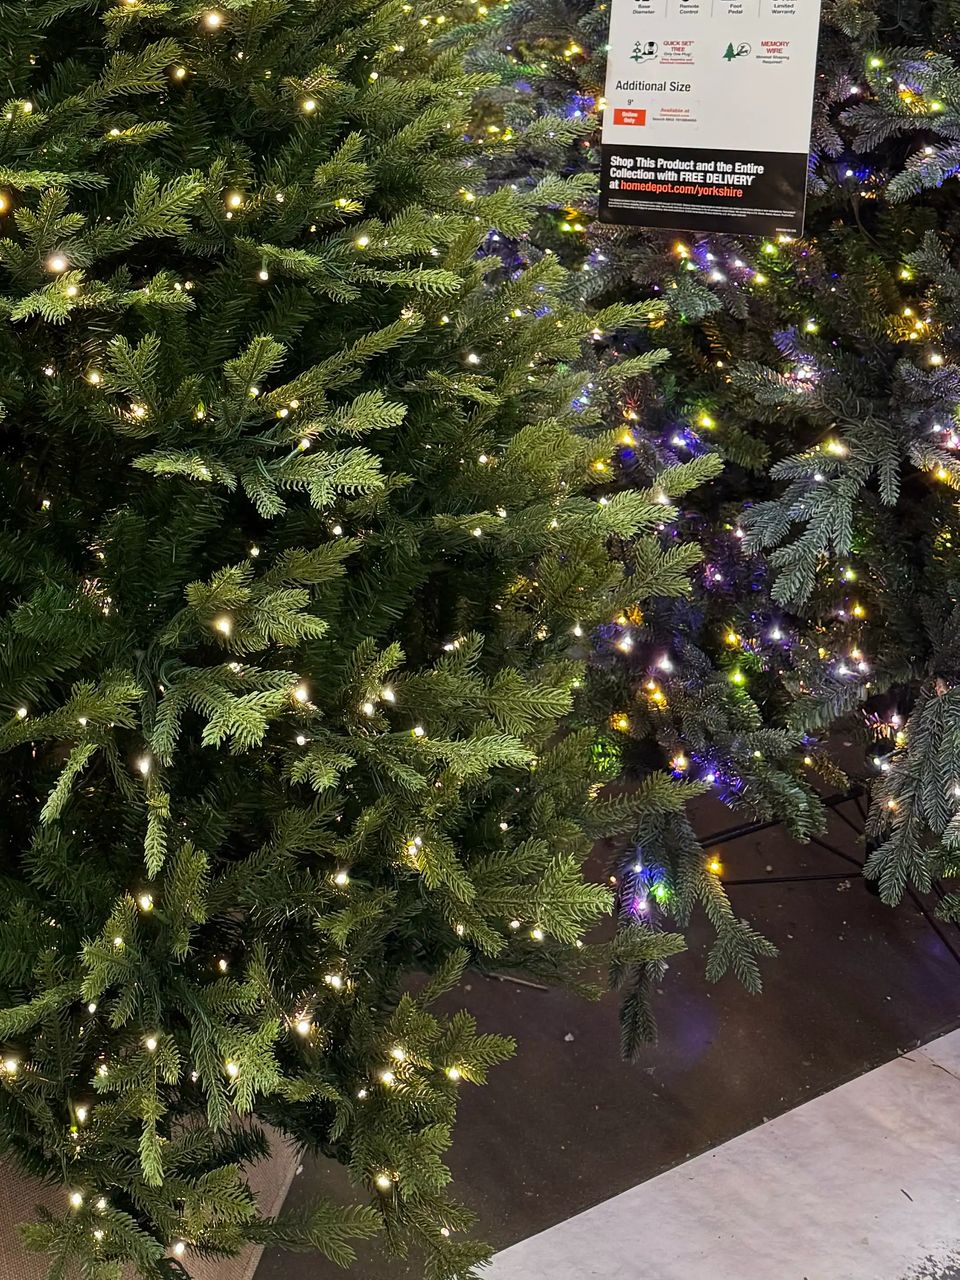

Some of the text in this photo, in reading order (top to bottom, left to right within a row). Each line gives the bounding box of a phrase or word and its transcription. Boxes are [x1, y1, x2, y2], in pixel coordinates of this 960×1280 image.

[616, 80, 692, 93] Additional Size
[610, 156, 765, 175] Shop This Product and the Entire
[609, 168, 655, 180] Collection
[656, 170, 678, 182] with
[680, 172, 704, 183] FREE
[609, 180, 743, 198] at homedepot.com/yorkshire
